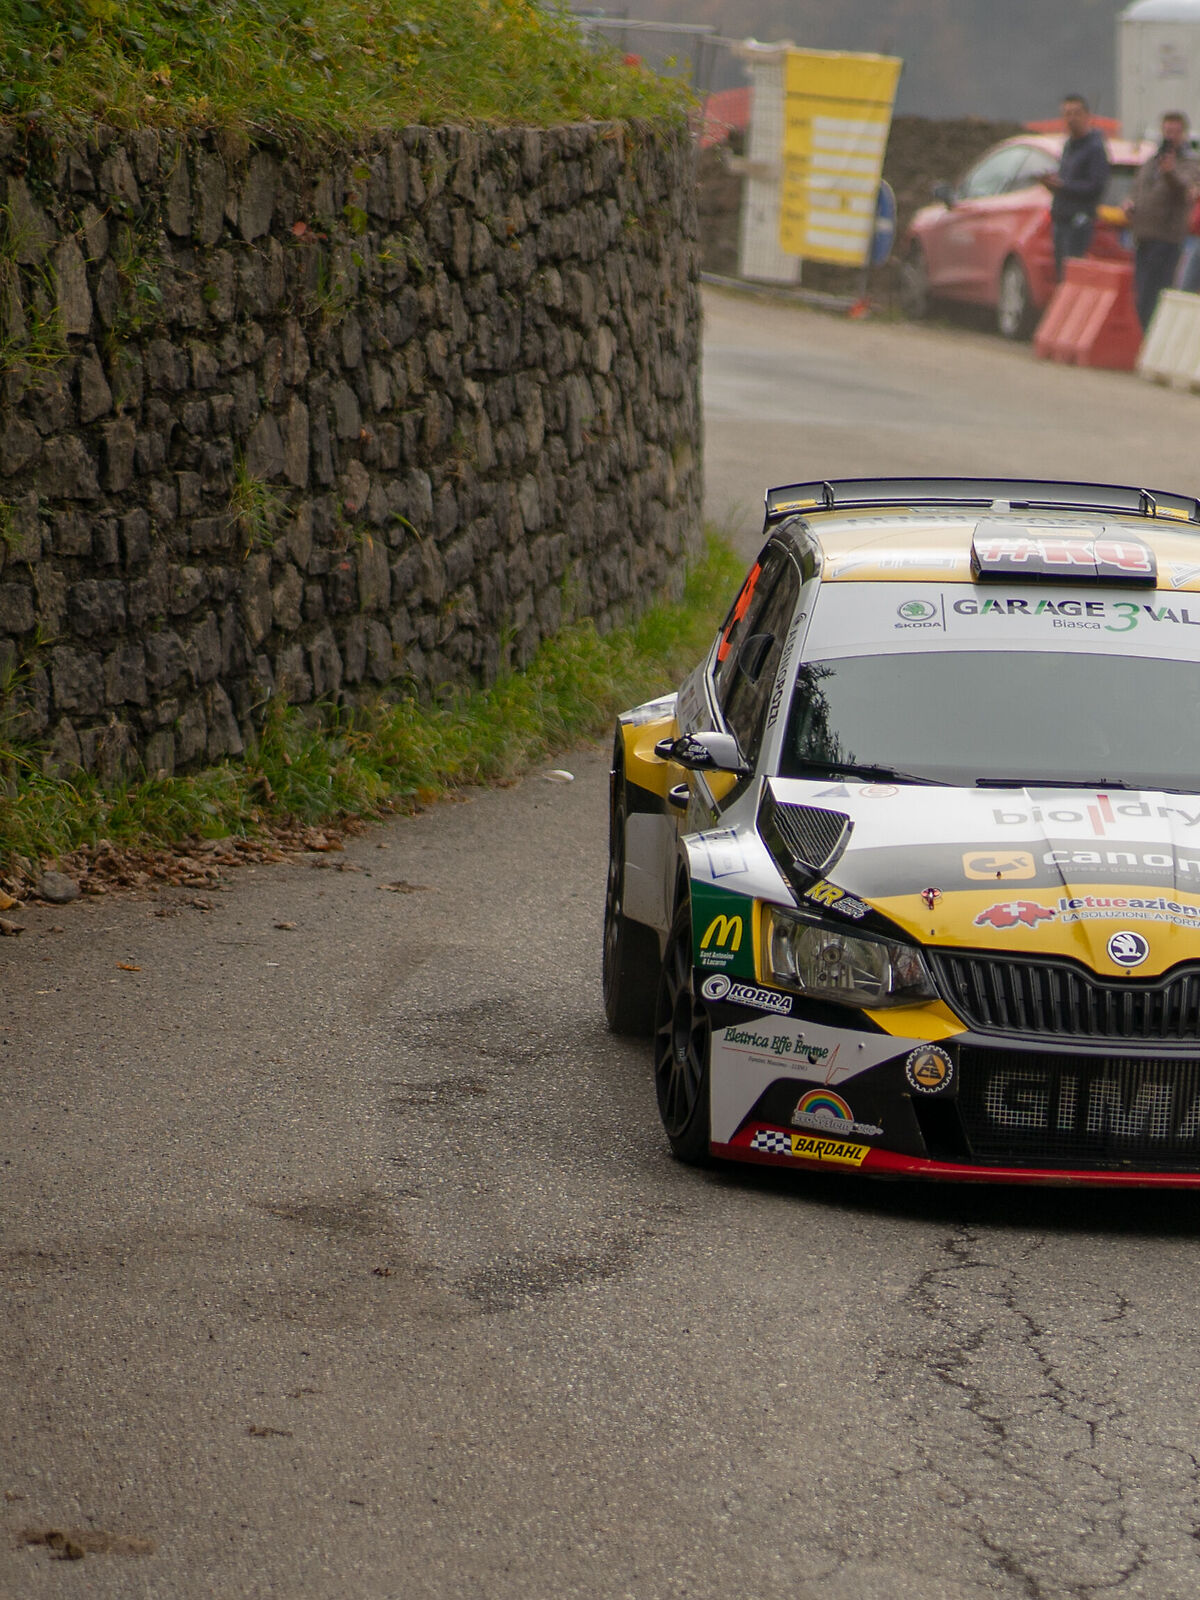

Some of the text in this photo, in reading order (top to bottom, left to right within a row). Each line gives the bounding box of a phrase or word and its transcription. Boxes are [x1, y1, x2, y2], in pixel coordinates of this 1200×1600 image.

[953, 599, 1105, 618] GARAGE
[1104, 602, 1140, 632] 3
[1053, 619, 1100, 630] Biasca
[803, 879, 845, 907] KR
[1063, 913, 1079, 922] LA
[731, 984, 793, 1010] KOBRA
[724, 1028, 829, 1058] Elettrica Effe Emme
[794, 1138, 862, 1160] BARDAHL
